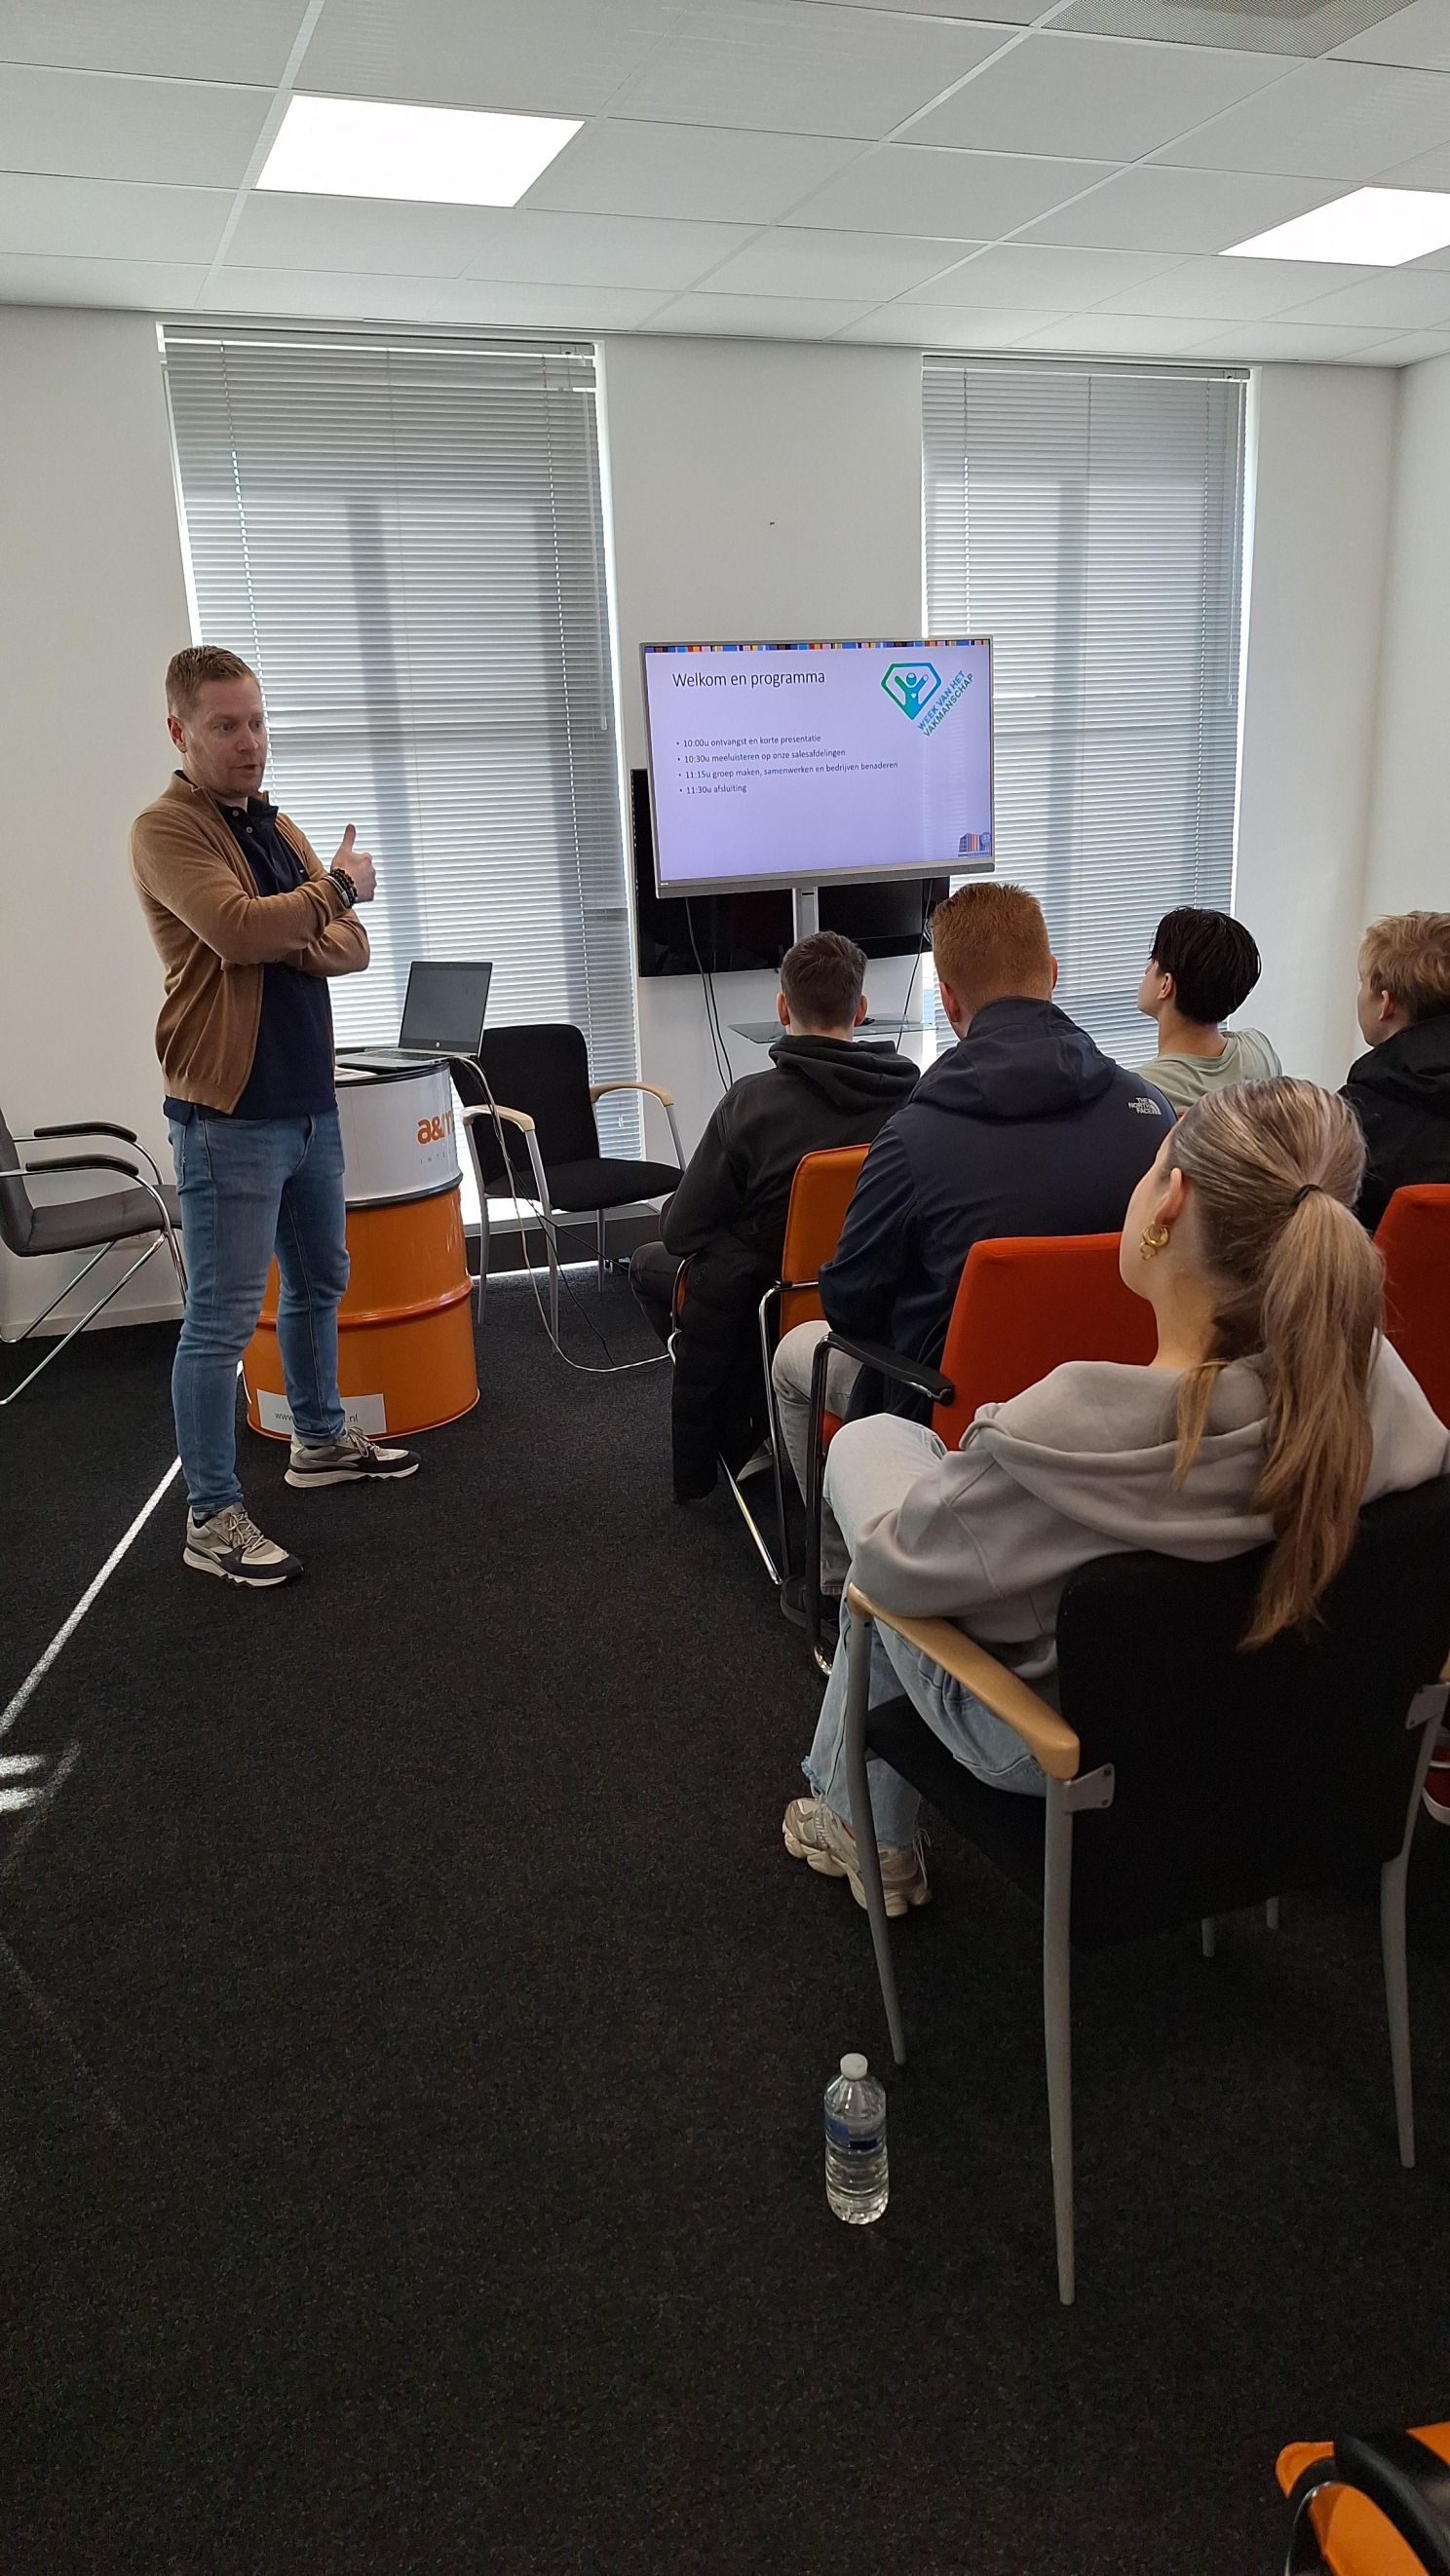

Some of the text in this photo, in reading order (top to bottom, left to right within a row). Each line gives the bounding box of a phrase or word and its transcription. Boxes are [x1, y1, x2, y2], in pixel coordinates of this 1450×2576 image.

[672, 672, 825, 688] Welkom en programma
[918, 670, 966, 731] WEEK VAN HET
[923, 673, 973, 738] VAKMANSCHAP
[683, 739, 709, 748] 10:00u
[710, 738, 746, 747] ontvangst
[759, 736, 779, 745] korte
[781, 734, 821, 745] presentatie
[684, 755, 710, 764] 10:30u
[711, 753, 760, 763] meeluisteren
[791, 748, 846, 759] salesafdelingen
[685, 771, 711, 779] 11:15u
[712, 770, 734, 779] groep
[736, 768, 763, 777] maken,
[764, 766, 814, 776] samenwerken
[825, 763, 859, 773] bedrijven
[860, 761, 898, 771] benaderen
[686, 783, 747, 795] 11:30u afsluiting
